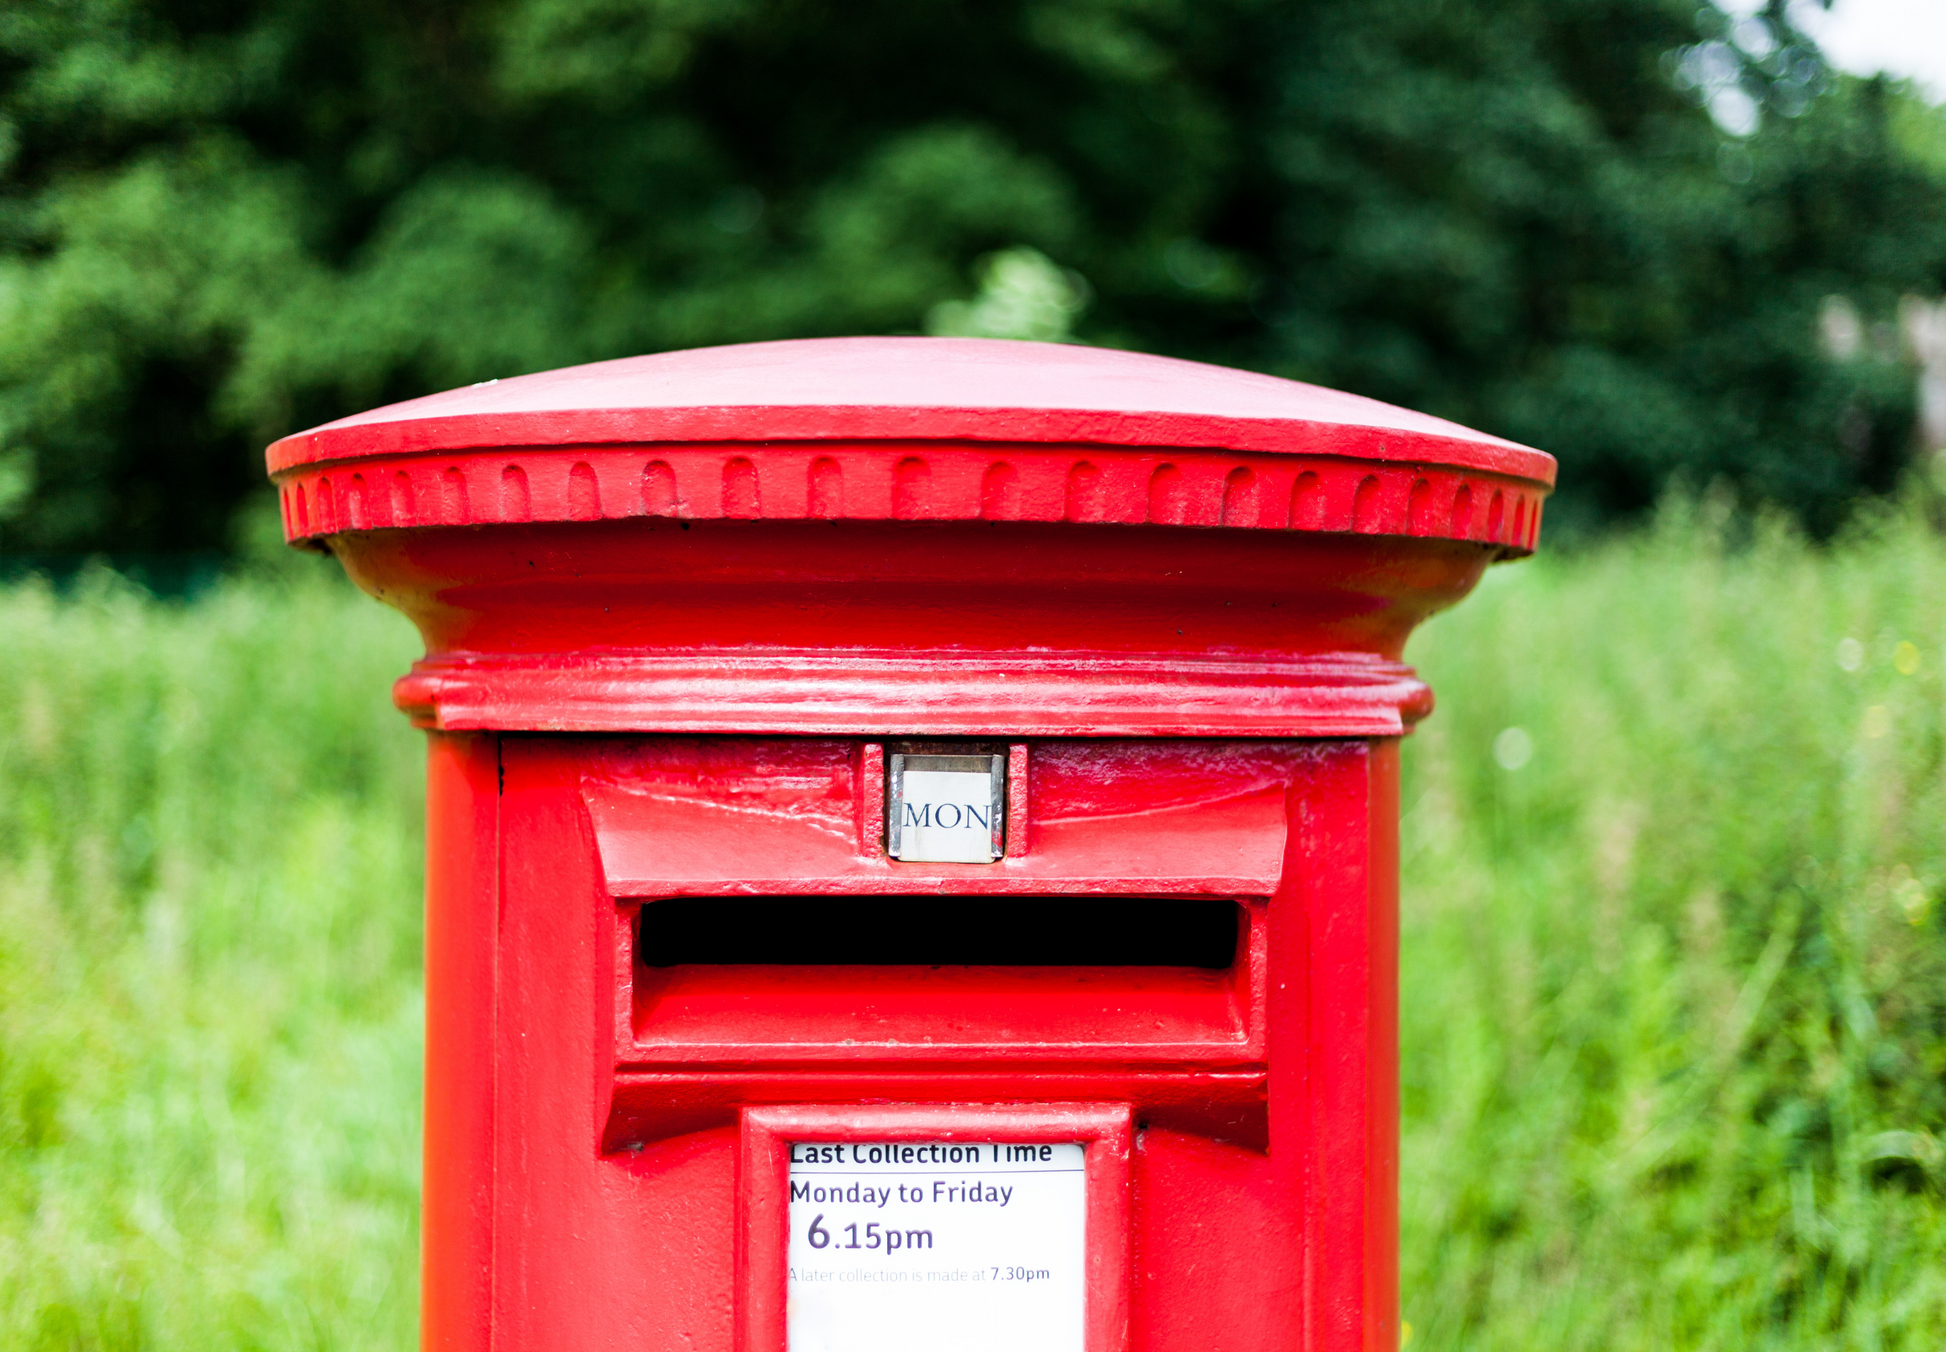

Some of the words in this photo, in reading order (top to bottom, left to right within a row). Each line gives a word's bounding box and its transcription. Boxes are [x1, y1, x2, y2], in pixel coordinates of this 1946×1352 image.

[903, 802, 992, 830] MON
[790, 1144, 845, 1164] Last
[852, 1144, 980, 1164] Collection
[990, 1144, 1053, 1163] Time
[790, 1180, 892, 1209] Monday
[898, 1183, 924, 1203] to
[932, 1180, 1014, 1208] Friday
[807, 1213, 933, 1256] 6.15pm
[790, 1267, 798, 1282] A
[801, 1268, 836, 1282] later
[839, 1267, 908, 1282] collection
[912, 1268, 923, 1282] is
[927, 1267, 968, 1282] made
[972, 1270, 986, 1282] at
[990, 1266, 1050, 1283] 7.30pm
